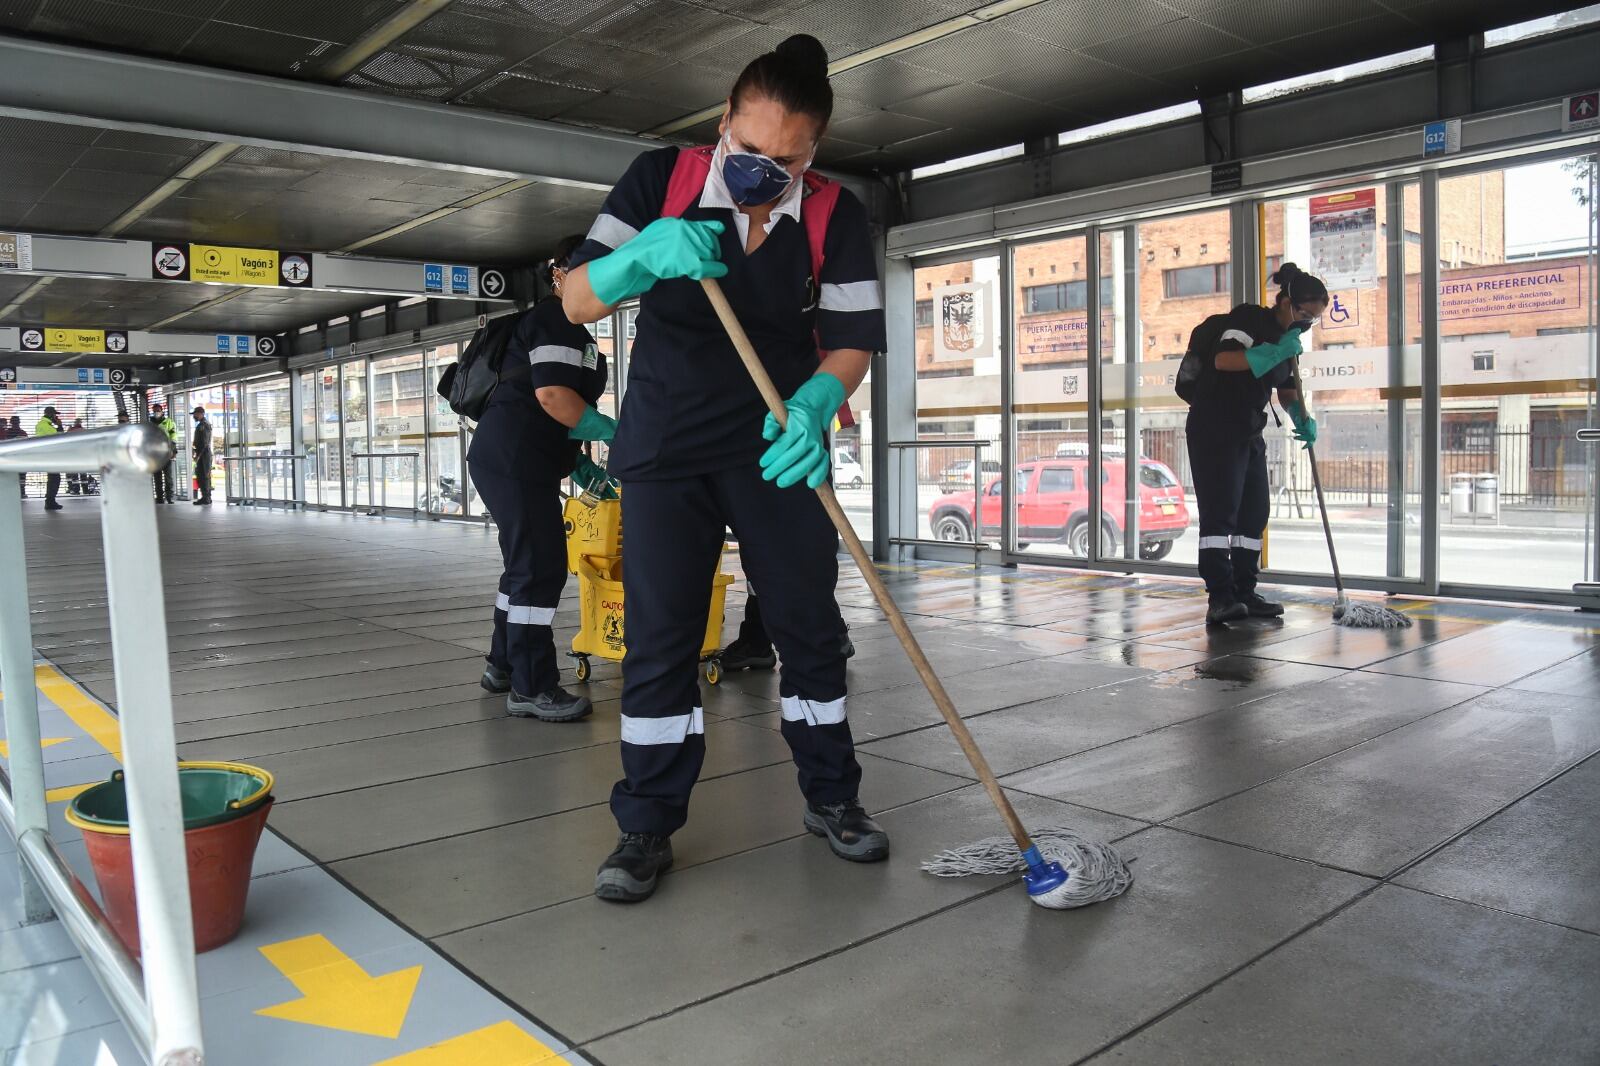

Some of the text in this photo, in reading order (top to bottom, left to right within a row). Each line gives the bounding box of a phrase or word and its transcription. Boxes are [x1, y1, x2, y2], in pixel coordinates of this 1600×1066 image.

[1425, 132, 1445, 144] G12
[241, 257, 274, 270] Vagón 3
[426, 271, 441, 281] G12
[453, 273, 468, 283] G22
[1439, 273, 1565, 296] UERTA PREFERENCIAL
[1442, 290, 1553, 307] Embarazadas Niños Ancianos
[1472, 304, 1505, 313] condición
[1507, 302, 1516, 310] de
[1518, 297, 1566, 308] discapacidad
[601, 600, 625, 611] CAUTIO
